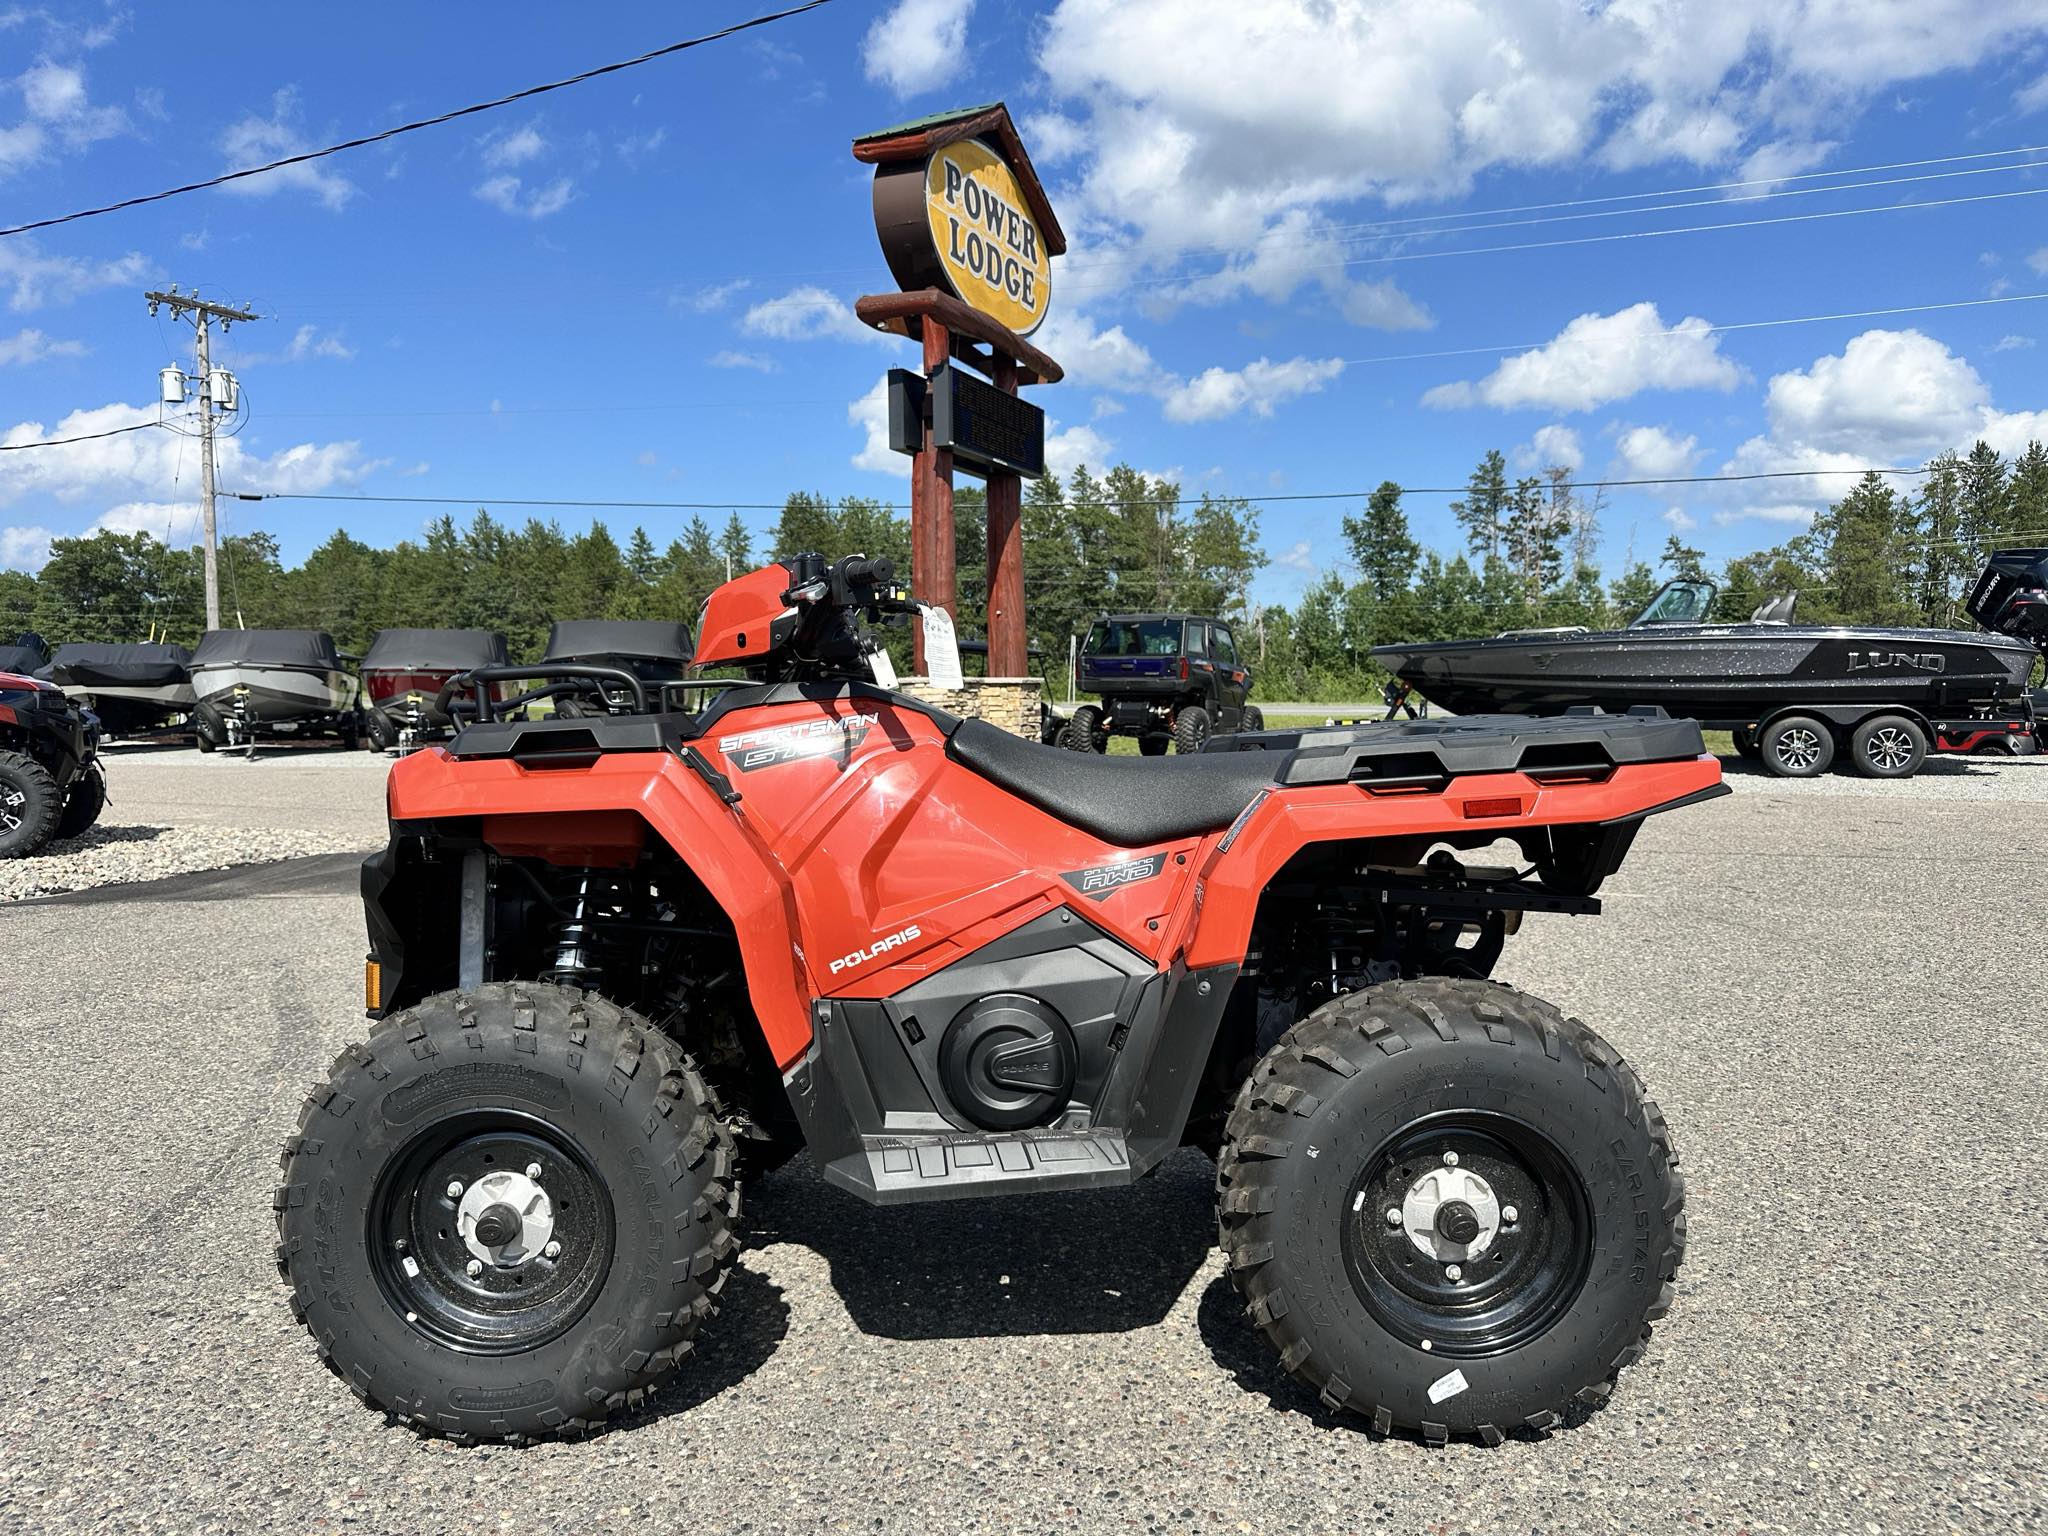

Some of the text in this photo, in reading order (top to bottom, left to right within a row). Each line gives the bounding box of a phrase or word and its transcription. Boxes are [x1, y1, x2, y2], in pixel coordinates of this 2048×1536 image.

[943, 160, 1038, 265] POWER
[949, 217, 1036, 311] LODGE
[1846, 652, 1946, 673] LUND
[718, 712, 879, 753] SPORTSMAN
[1082, 863, 1154, 890] AWD
[829, 925, 922, 974] POLARIS
[626, 1145, 664, 1296] CARLSTAR
[1610, 1137, 1650, 1285] CARLSTAR
